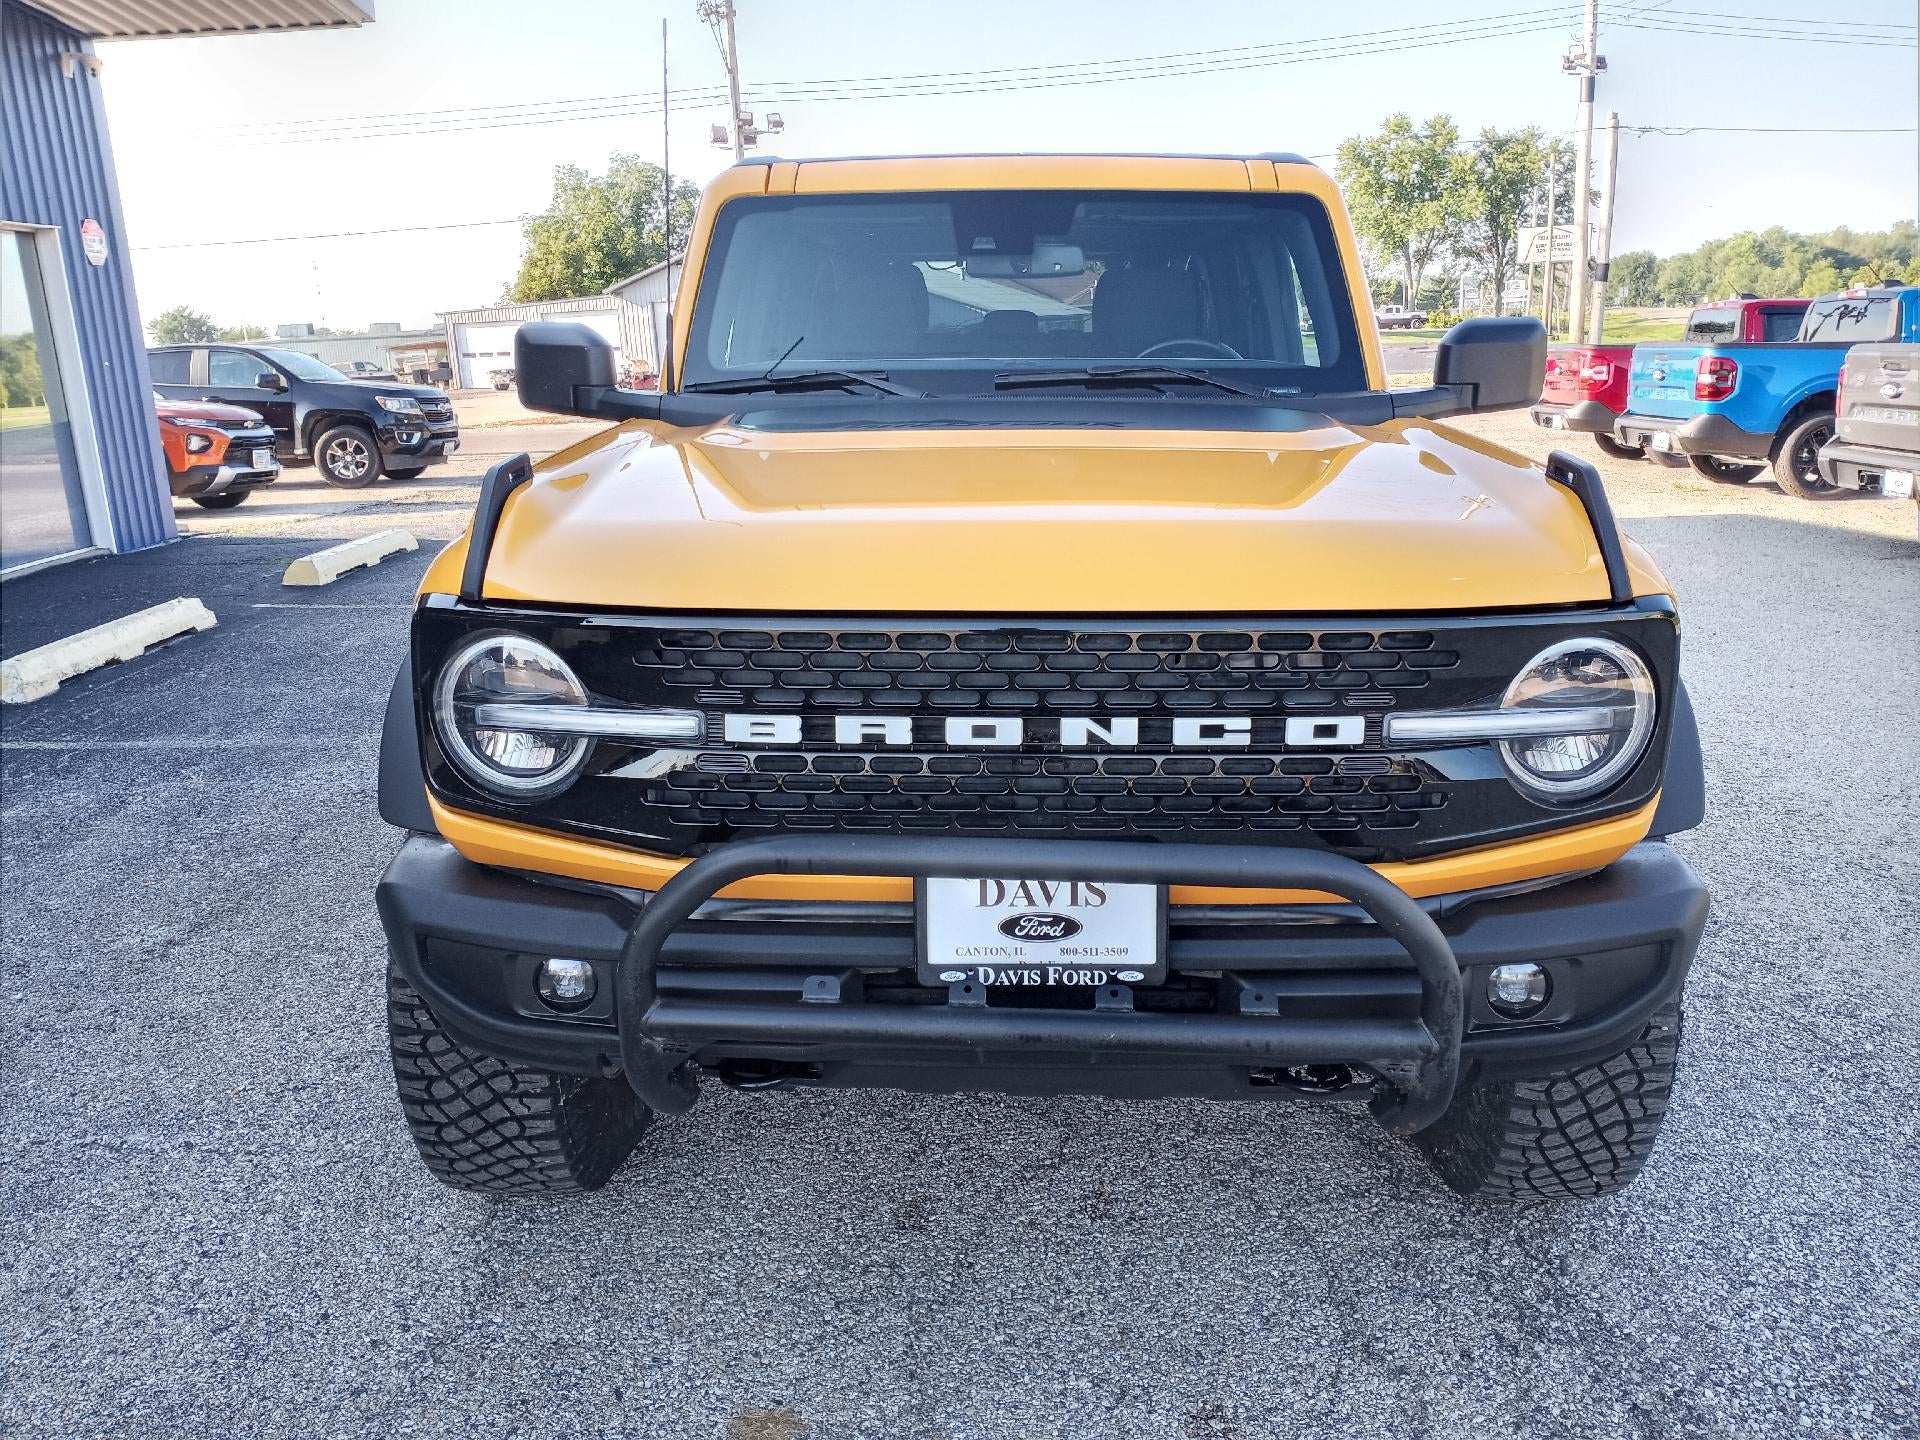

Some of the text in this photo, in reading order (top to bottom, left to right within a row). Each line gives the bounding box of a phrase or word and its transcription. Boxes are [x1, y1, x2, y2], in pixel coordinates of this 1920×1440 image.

[724, 714, 1365, 747] BRONCO
[976, 879, 1107, 908] DAVIS
[1015, 915, 1065, 938] Ford
[955, 947, 1027, 959] CANTON, IL
[1059, 947, 1129, 957] 800-511-3509
[977, 967, 1108, 986] DAVIS FORD
